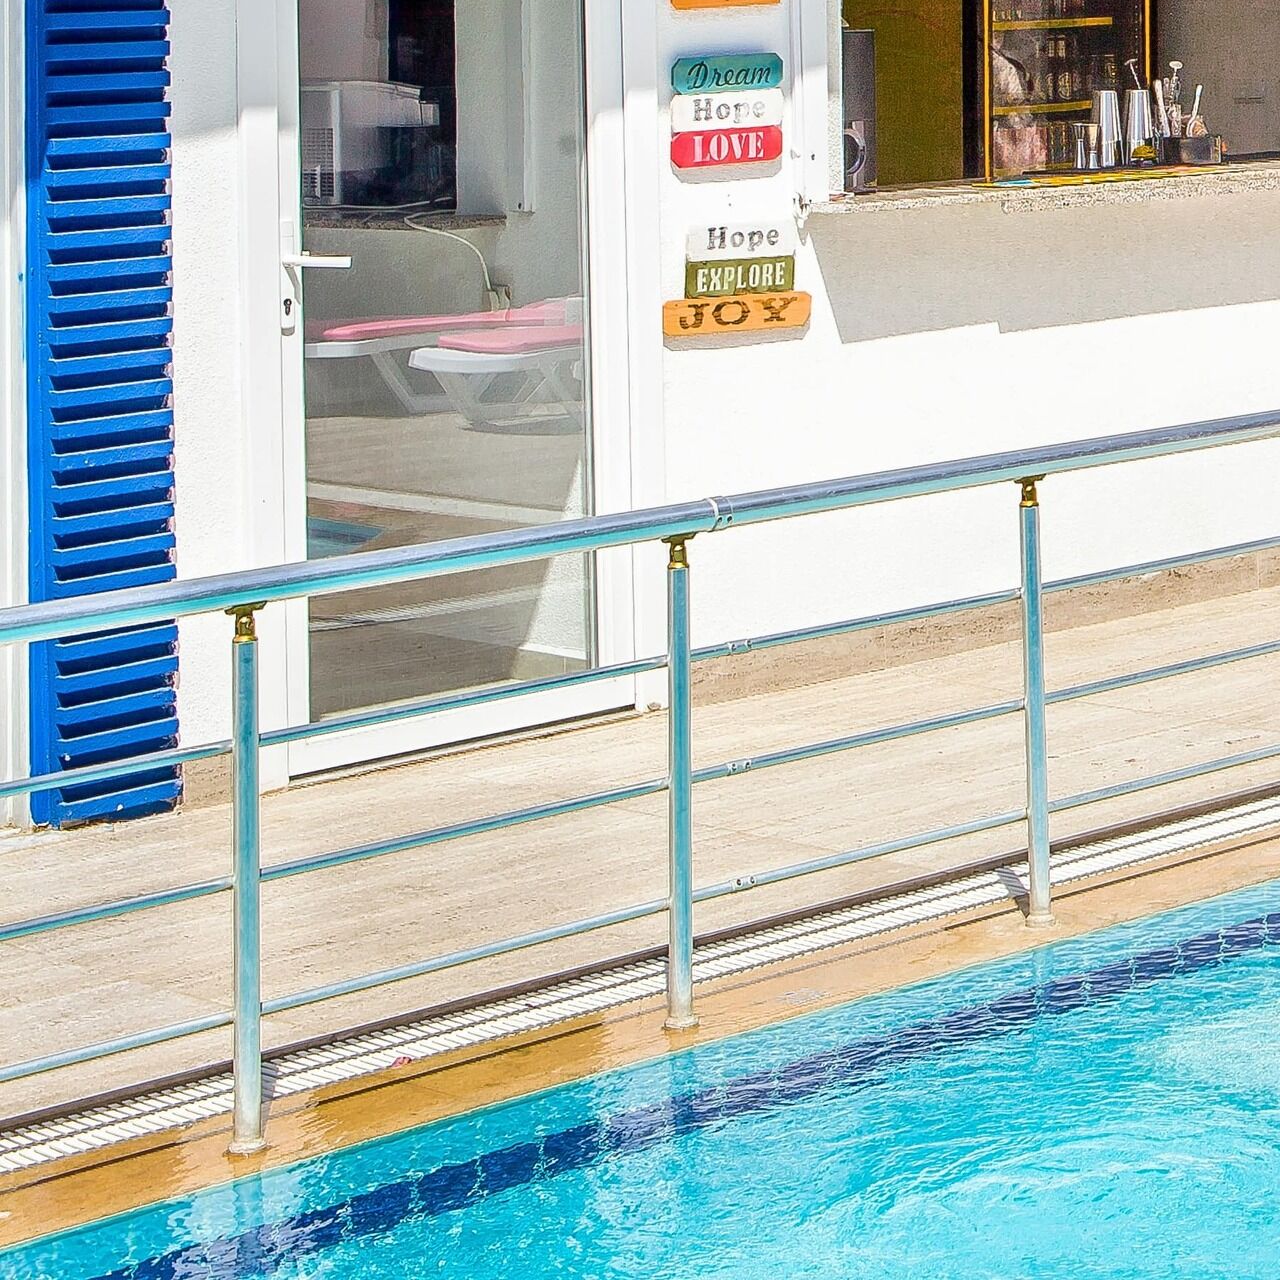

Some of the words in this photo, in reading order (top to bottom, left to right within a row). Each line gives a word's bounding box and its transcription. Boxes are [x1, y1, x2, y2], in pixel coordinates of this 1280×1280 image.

[687, 58, 773, 90] Dream
[692, 98, 767, 124] Hope
[692, 131, 765, 164] LOVE
[706, 226, 780, 252] Hope
[696, 261, 786, 293] EXPLORE
[679, 296, 798, 330] JOY
